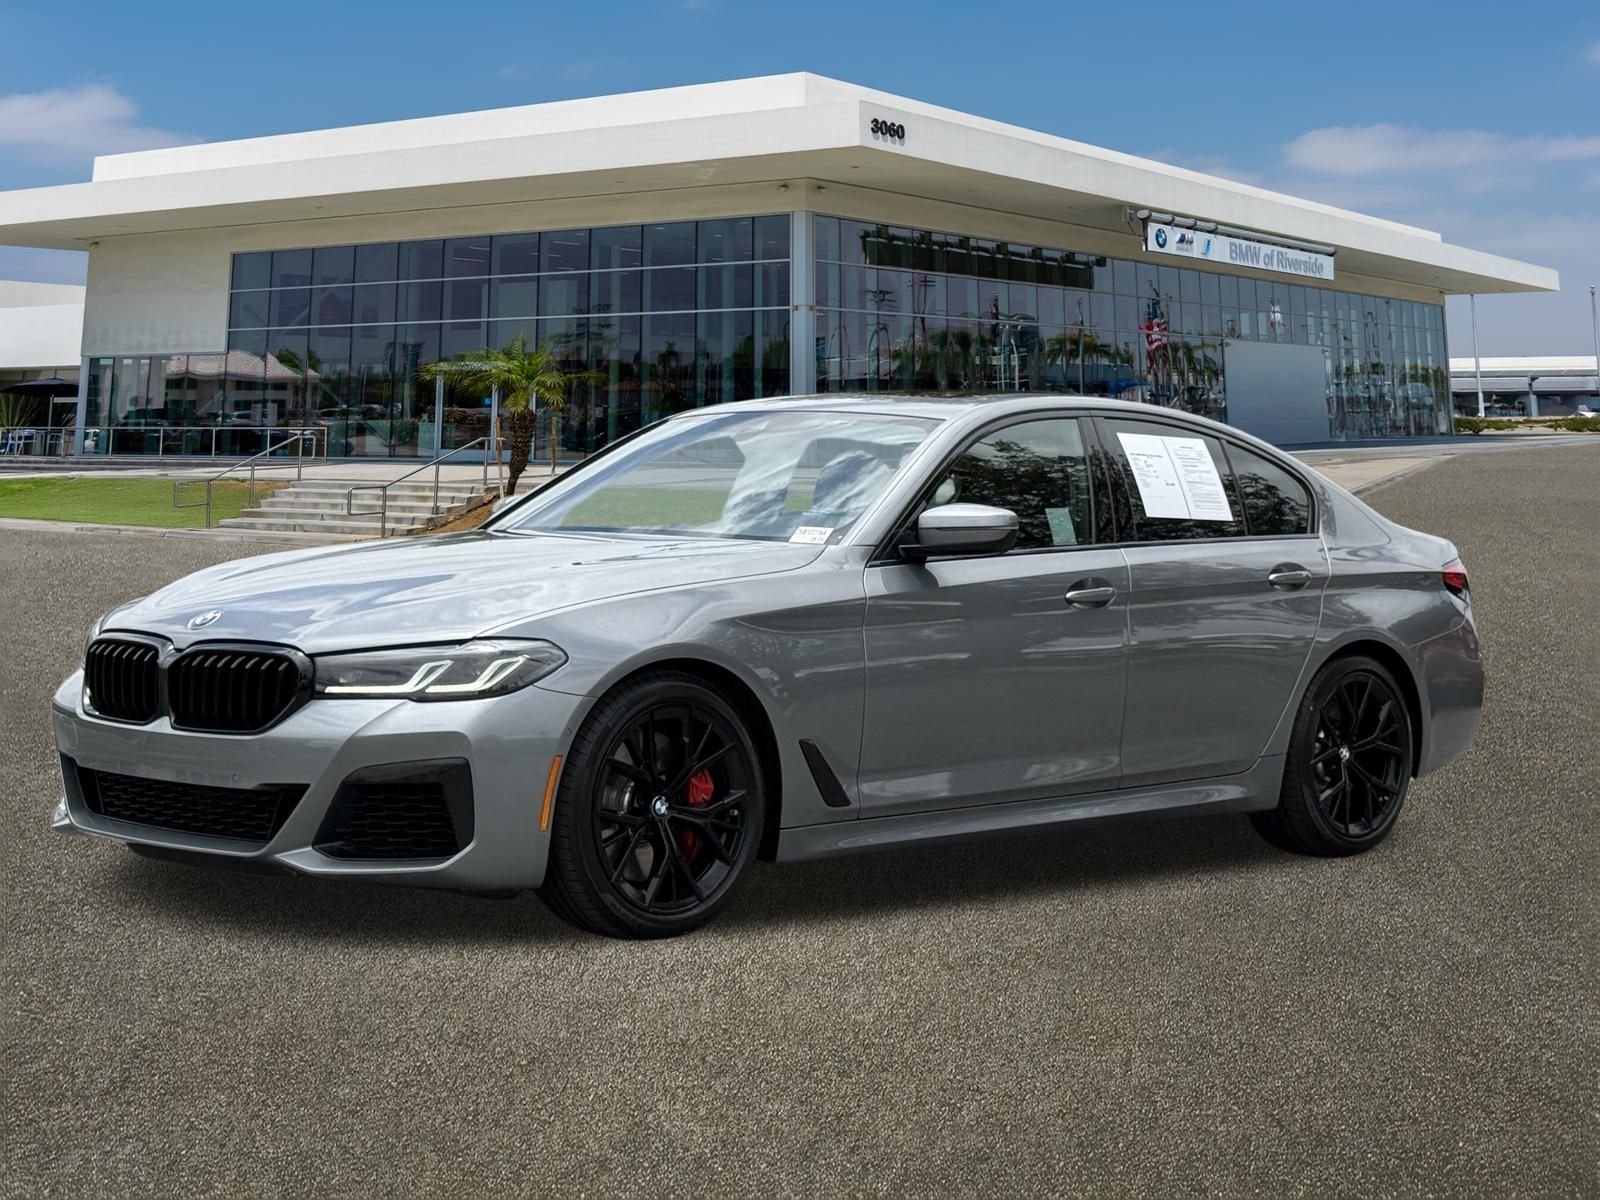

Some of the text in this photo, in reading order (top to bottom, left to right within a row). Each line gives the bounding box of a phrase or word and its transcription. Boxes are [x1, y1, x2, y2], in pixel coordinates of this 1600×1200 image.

[870, 117, 906, 139] 3060
[1229, 241, 1325, 275] BMW of Riverside
